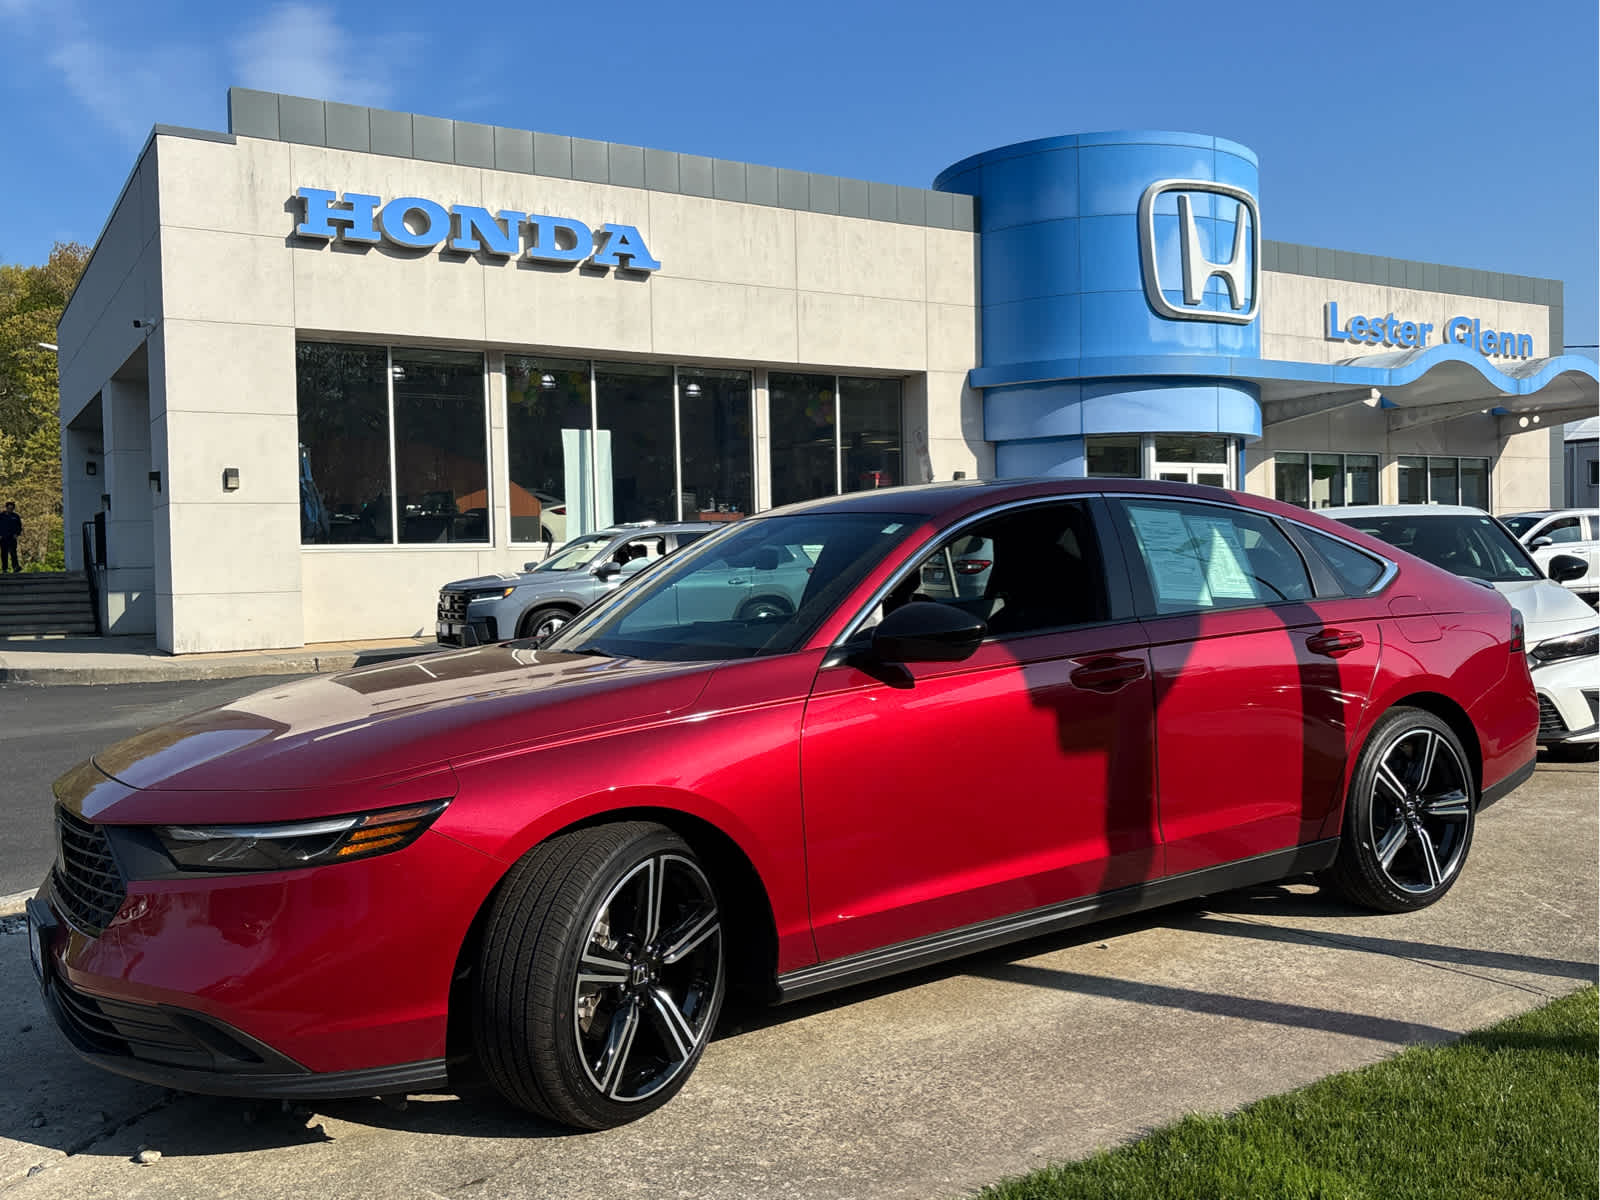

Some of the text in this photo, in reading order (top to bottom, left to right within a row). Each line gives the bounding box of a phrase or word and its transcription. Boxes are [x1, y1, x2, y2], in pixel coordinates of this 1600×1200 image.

[297, 187, 661, 272] HONDA
[1327, 301, 1533, 357] Lester Glenn
